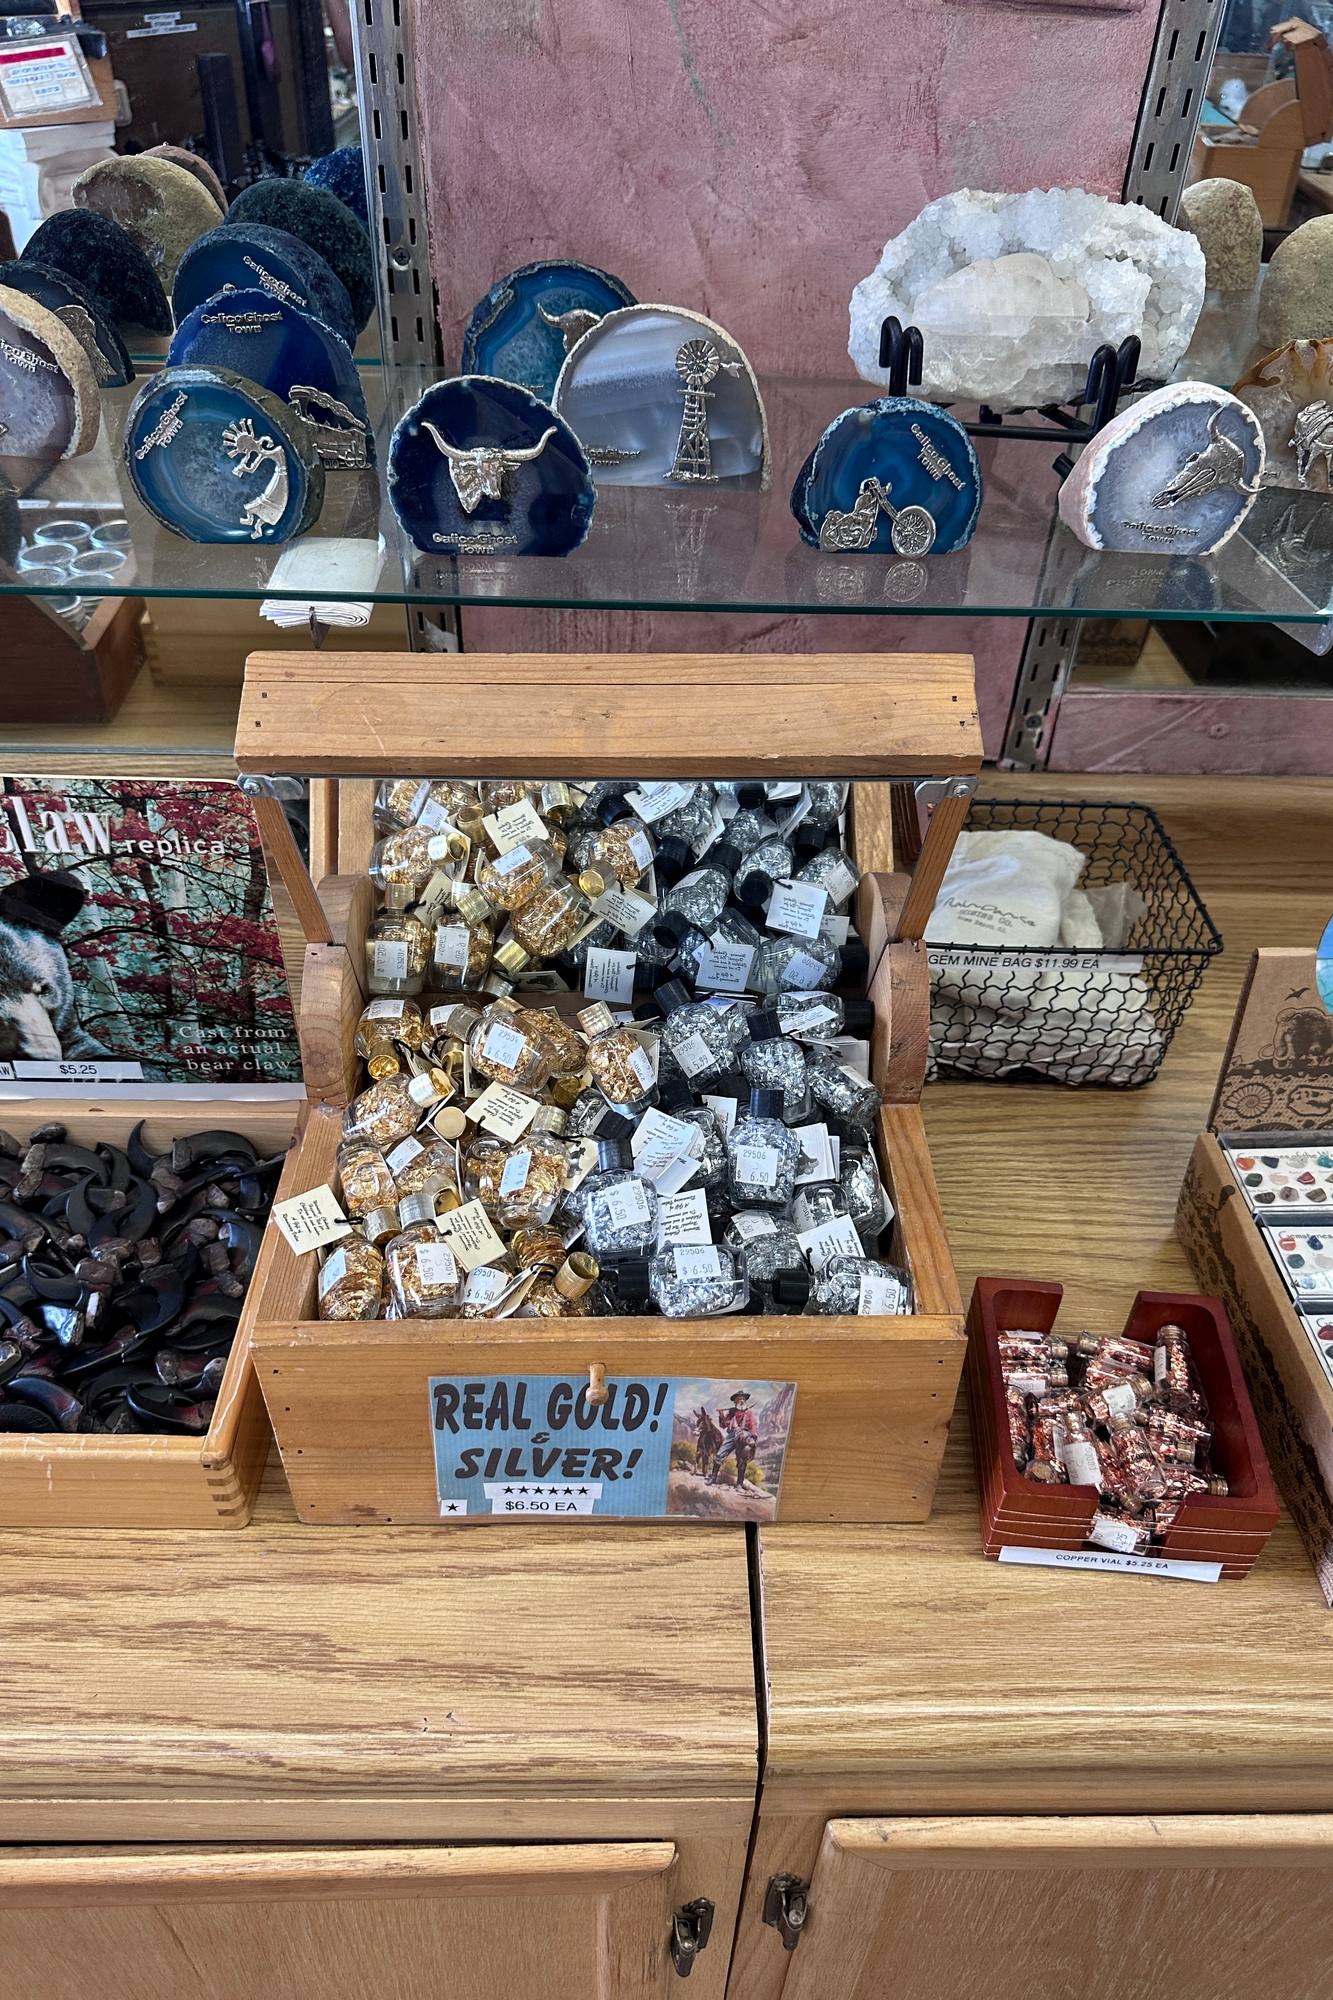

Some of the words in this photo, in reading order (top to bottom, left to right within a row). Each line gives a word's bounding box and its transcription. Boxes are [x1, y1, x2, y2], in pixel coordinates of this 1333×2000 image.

[432, 532, 476, 545] Calico
[476, 532, 519, 545] Ghost
[458, 544, 495, 555] Town
[125, 838, 226, 857] replica
[928, 954, 960, 966] GEM
[963, 956, 1000, 967] MINE
[1002, 958, 1032, 968] BAG
[1034, 958, 1079, 969] $11.99
[1081, 958, 1100, 969] EA
[179, 1026, 226, 1038] Cast
[235, 1026, 287, 1038] from
[183, 1044, 200, 1054] an
[216, 1042, 282, 1054] actual
[188, 1058, 236, 1072] bear
[244, 1058, 291, 1071] claw
[692, 1054, 709, 1070] 5.99
[60, 1064, 98, 1075] $5.25
[742, 1148, 766, 1159] 29506
[749, 1170, 768, 1182] 6.50
[630, 1184, 647, 1210] 29506
[609, 1197, 628, 1221] 6.50
[679, 1246, 705, 1256] 29506
[691, 1262, 713, 1274] 6.50
[474, 1287, 494, 1301] 6.50
[434, 1381, 532, 1435] REAL
[546, 1382, 669, 1434] GOLD!
[530, 1432, 551, 1445] &
[454, 1447, 644, 1482] SILVER!
[504, 1498, 550, 1512] $6.50
[554, 1500, 578, 1512] EA
[1056, 1554, 1098, 1564] COPPER
[1101, 1558, 1122, 1566] VIAL
[1126, 1560, 1153, 1568] $5.25
